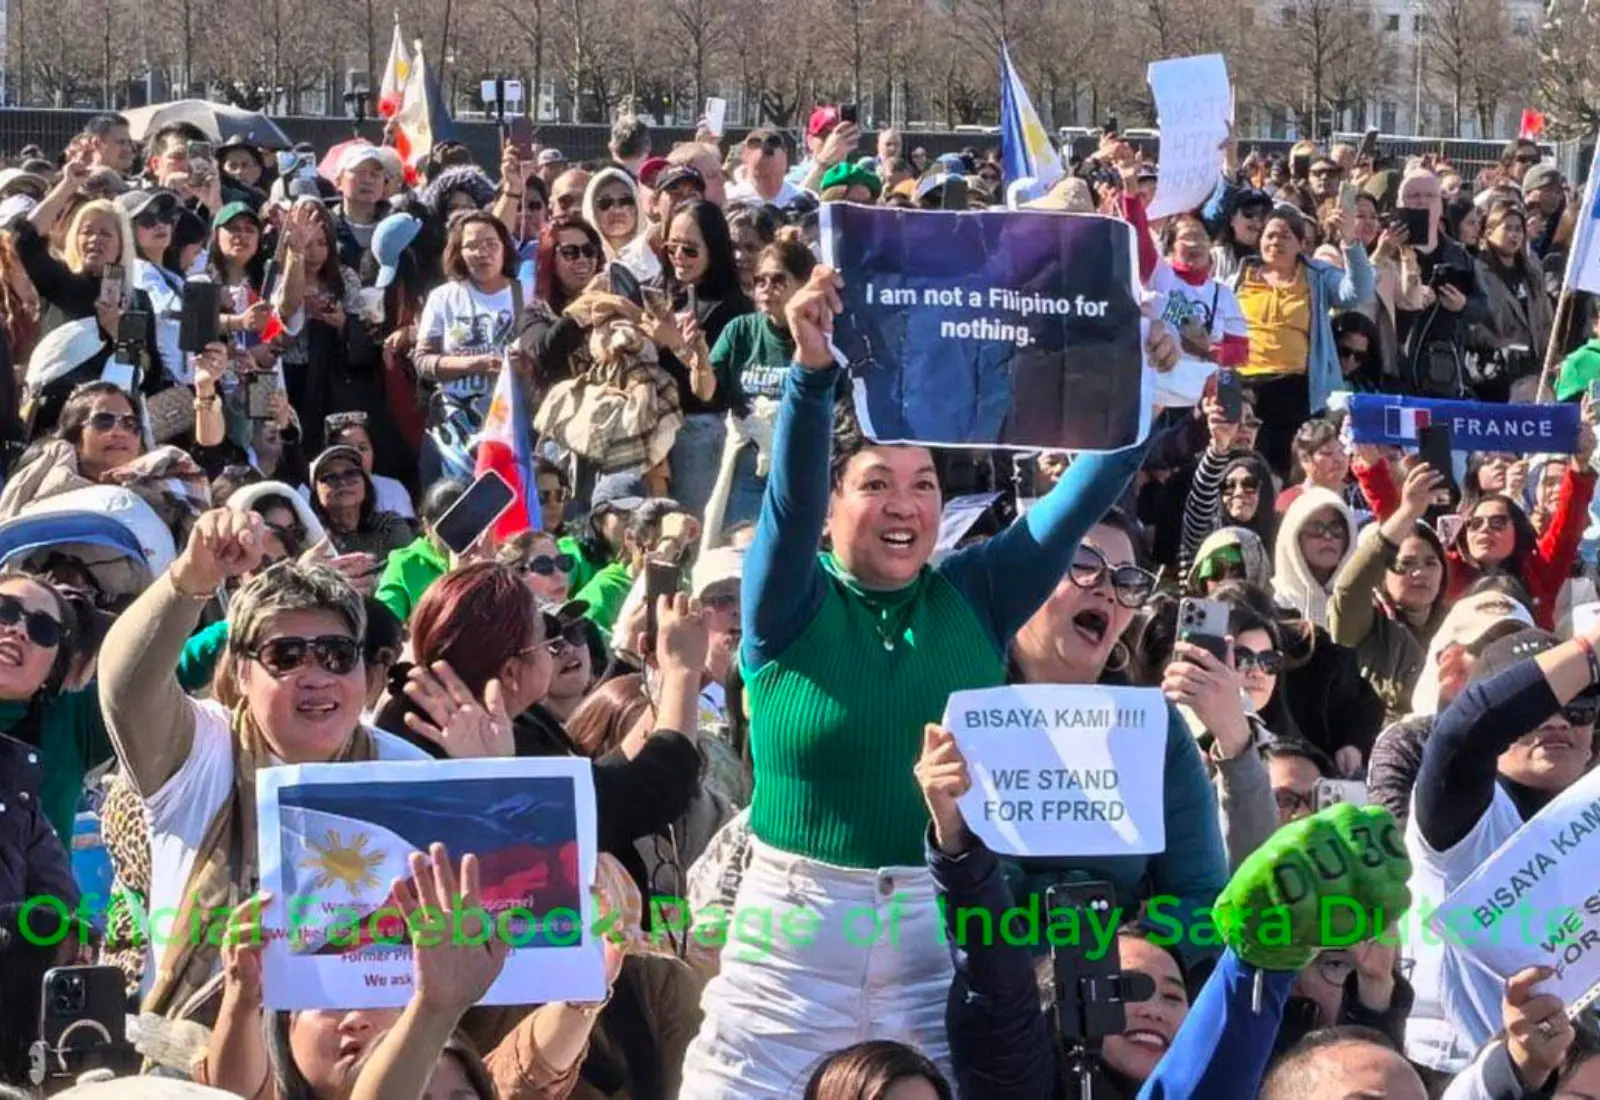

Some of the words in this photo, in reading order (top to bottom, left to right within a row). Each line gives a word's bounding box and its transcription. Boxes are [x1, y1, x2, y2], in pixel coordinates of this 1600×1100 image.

[866, 283, 873, 304] I
[880, 288, 917, 305] am
[924, 285, 963, 307] not
[968, 289, 982, 308] a
[989, 287, 1070, 317] Filipino
[1075, 294, 1109, 317] for
[940, 317, 1036, 347] nothing.
[1453, 417, 1552, 437] FRANCE
[965, 709, 1048, 728] BISAYA
[1055, 709, 1109, 728] KAMI
[992, 769, 1029, 790] WE
[1038, 769, 1118, 790] STAND
[984, 801, 1033, 821] FOR
[1042, 801, 1124, 822] FPRRD
[1473, 853, 1557, 928] BISAYA
[1550, 797, 1600, 855] KAM
[1540, 911, 1583, 953] WE
[364, 973, 387, 987] We
